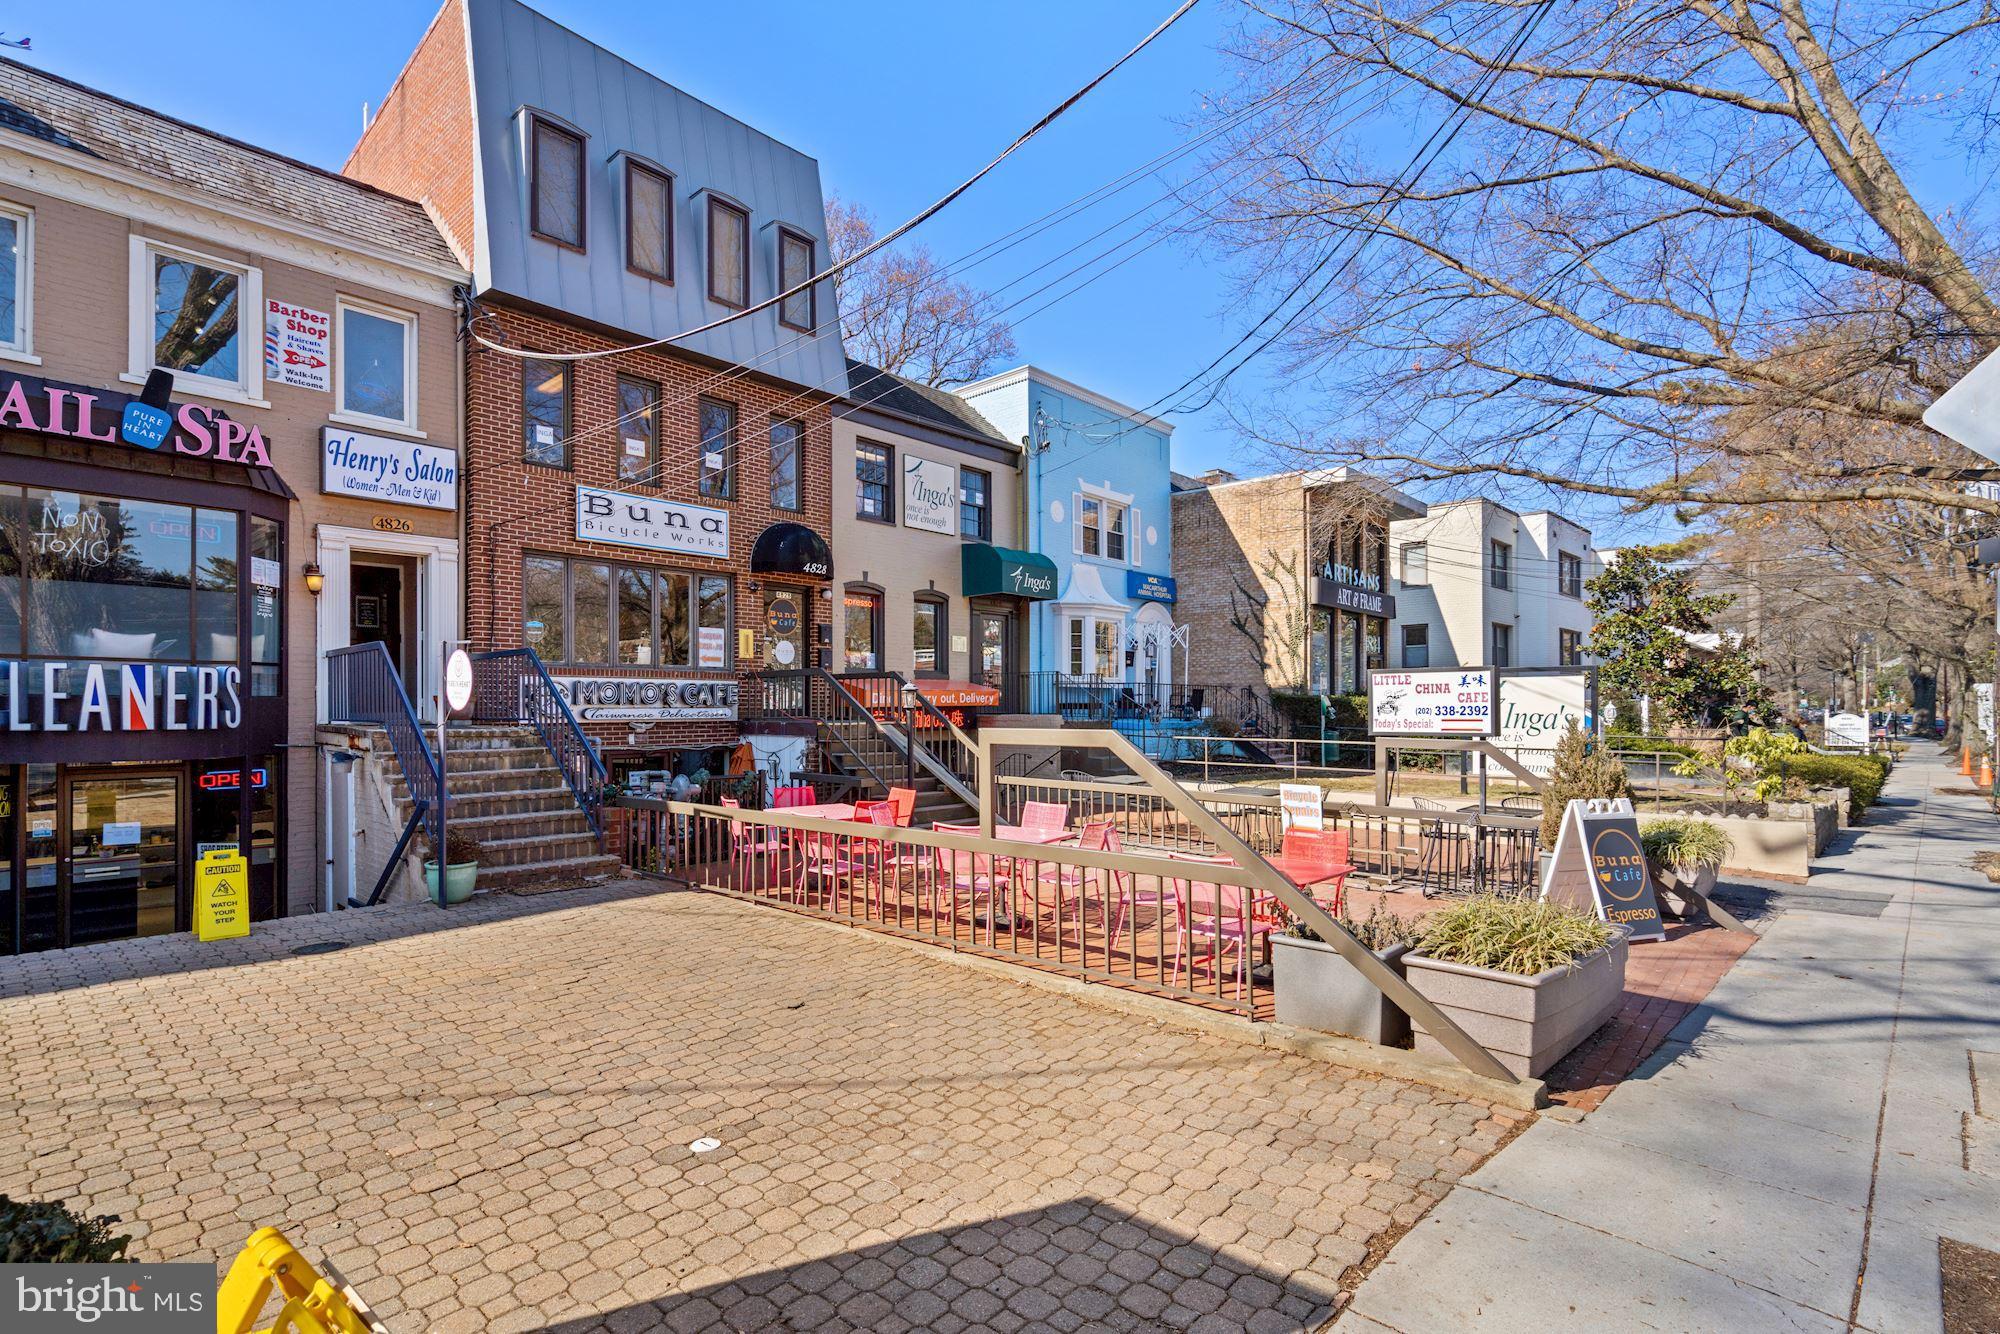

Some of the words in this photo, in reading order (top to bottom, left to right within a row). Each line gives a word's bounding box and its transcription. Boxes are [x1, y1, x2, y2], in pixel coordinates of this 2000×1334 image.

[269, 301, 327, 324] Barber
[286, 319, 327, 340] Shop
[287, 335, 321, 347] Haircuts
[296, 344, 324, 355] Shaves
[292, 355, 317, 365] OPEN
[285, 368, 323, 381] Walk-Ins
[285, 377, 324, 389] Welcome
[0, 380, 116, 443] AIL
[175, 403, 273, 467] SPA
[133, 410, 163, 426] PURE
[138, 420, 151, 429] IN
[123, 423, 163, 441] HEART
[328, 437, 399, 482] Henry's
[405, 448, 454, 484] Salon
[342, 475, 378, 492] (Women
[386, 482, 411, 498] Men
[413, 486, 421, 499] &
[917, 481, 954, 510] Inga's
[584, 493, 724, 534] Buna
[906, 504, 922, 513] once
[924, 505, 929, 515] is
[375, 518, 400, 531] 4826
[906, 512, 918, 521] not
[920, 515, 947, 528] enough
[151, 521, 215, 541] OPEN
[585, 520, 659, 538] Bicycle
[671, 532, 724, 548] Works
[803, 562, 827, 575] 4828
[1024, 573, 1050, 592] Inga's
[1324, 560, 1380, 592] ARTISANS
[843, 598, 873, 608] spresso
[1337, 588, 1352, 607] ART
[1353, 592, 1359, 607] &
[1360, 592, 1382, 612] FRAME
[769, 610, 797, 619] Buna
[779, 618, 795, 627] Cafe
[1374, 675, 1411, 685] LITTLE
[1458, 674, 1487, 688] 美味
[576, 680, 678, 706] MOMO'S
[684, 683, 739, 706] CAFE
[1415, 683, 1451, 694] CHINA
[0, 660, 241, 731] LEANERS
[872, 692, 894, 704] Din
[940, 694, 958, 704] out,
[959, 692, 994, 705] Delivery
[1457, 692, 1489, 703] CAFE
[589, 708, 654, 719] Taiwanese
[1415, 707, 1432, 715] (202)
[1434, 705, 1489, 716] 338-2392
[1374, 718, 1401, 730] Today's
[1403, 718, 1434, 730] Special:
[1503, 702, 1574, 737] Inga's
[1514, 731, 1524, 742] is
[1514, 743, 1555, 758] Enoug
[200, 771, 261, 788] OPEN
[1283, 790, 1318, 803] Bicycle
[1593, 854, 1642, 867] Buna
[206, 865, 240, 875] CAUTION
[1614, 867, 1642, 882] Cafe
[211, 900, 238, 908] WATCH
[1606, 905, 1657, 924] Espresso
